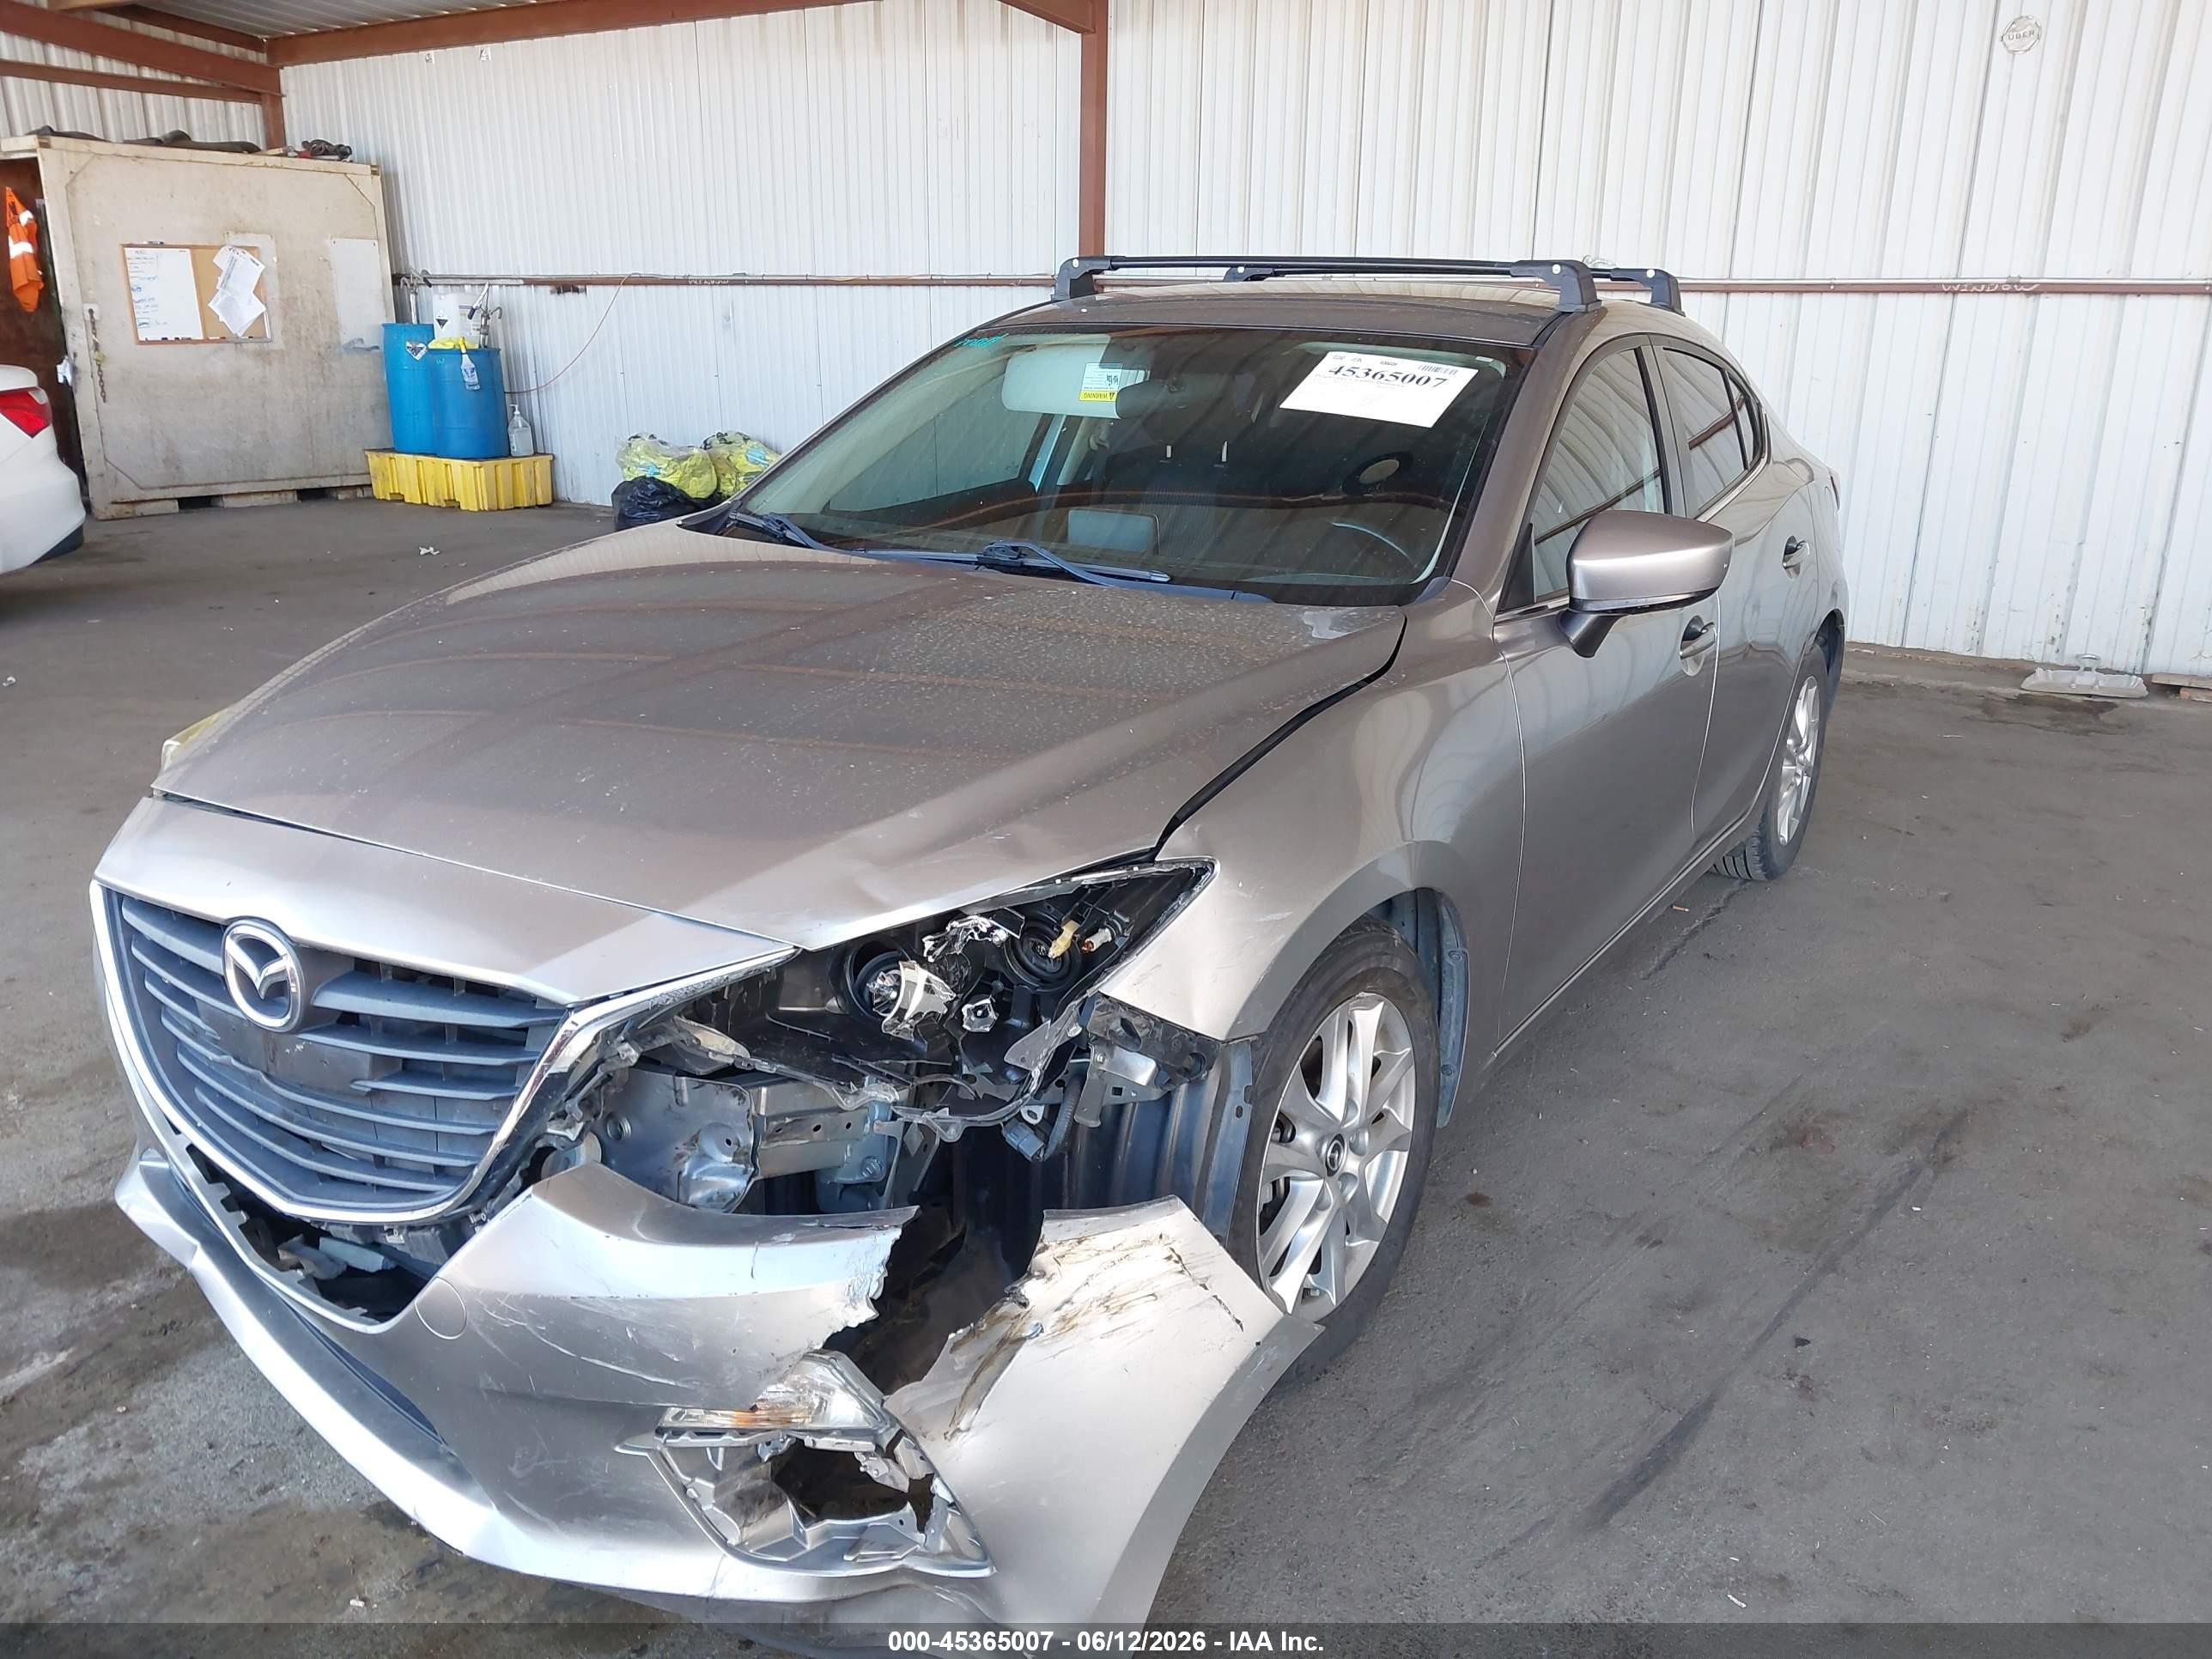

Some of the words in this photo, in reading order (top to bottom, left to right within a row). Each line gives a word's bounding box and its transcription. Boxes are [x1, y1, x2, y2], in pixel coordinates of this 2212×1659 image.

[2008, 29, 2035, 41] UBER
[1942, 283, 2041, 293] WINDOW
[1328, 364, 1449, 389] 45365007
[1083, 392, 1108, 400] WARNING
